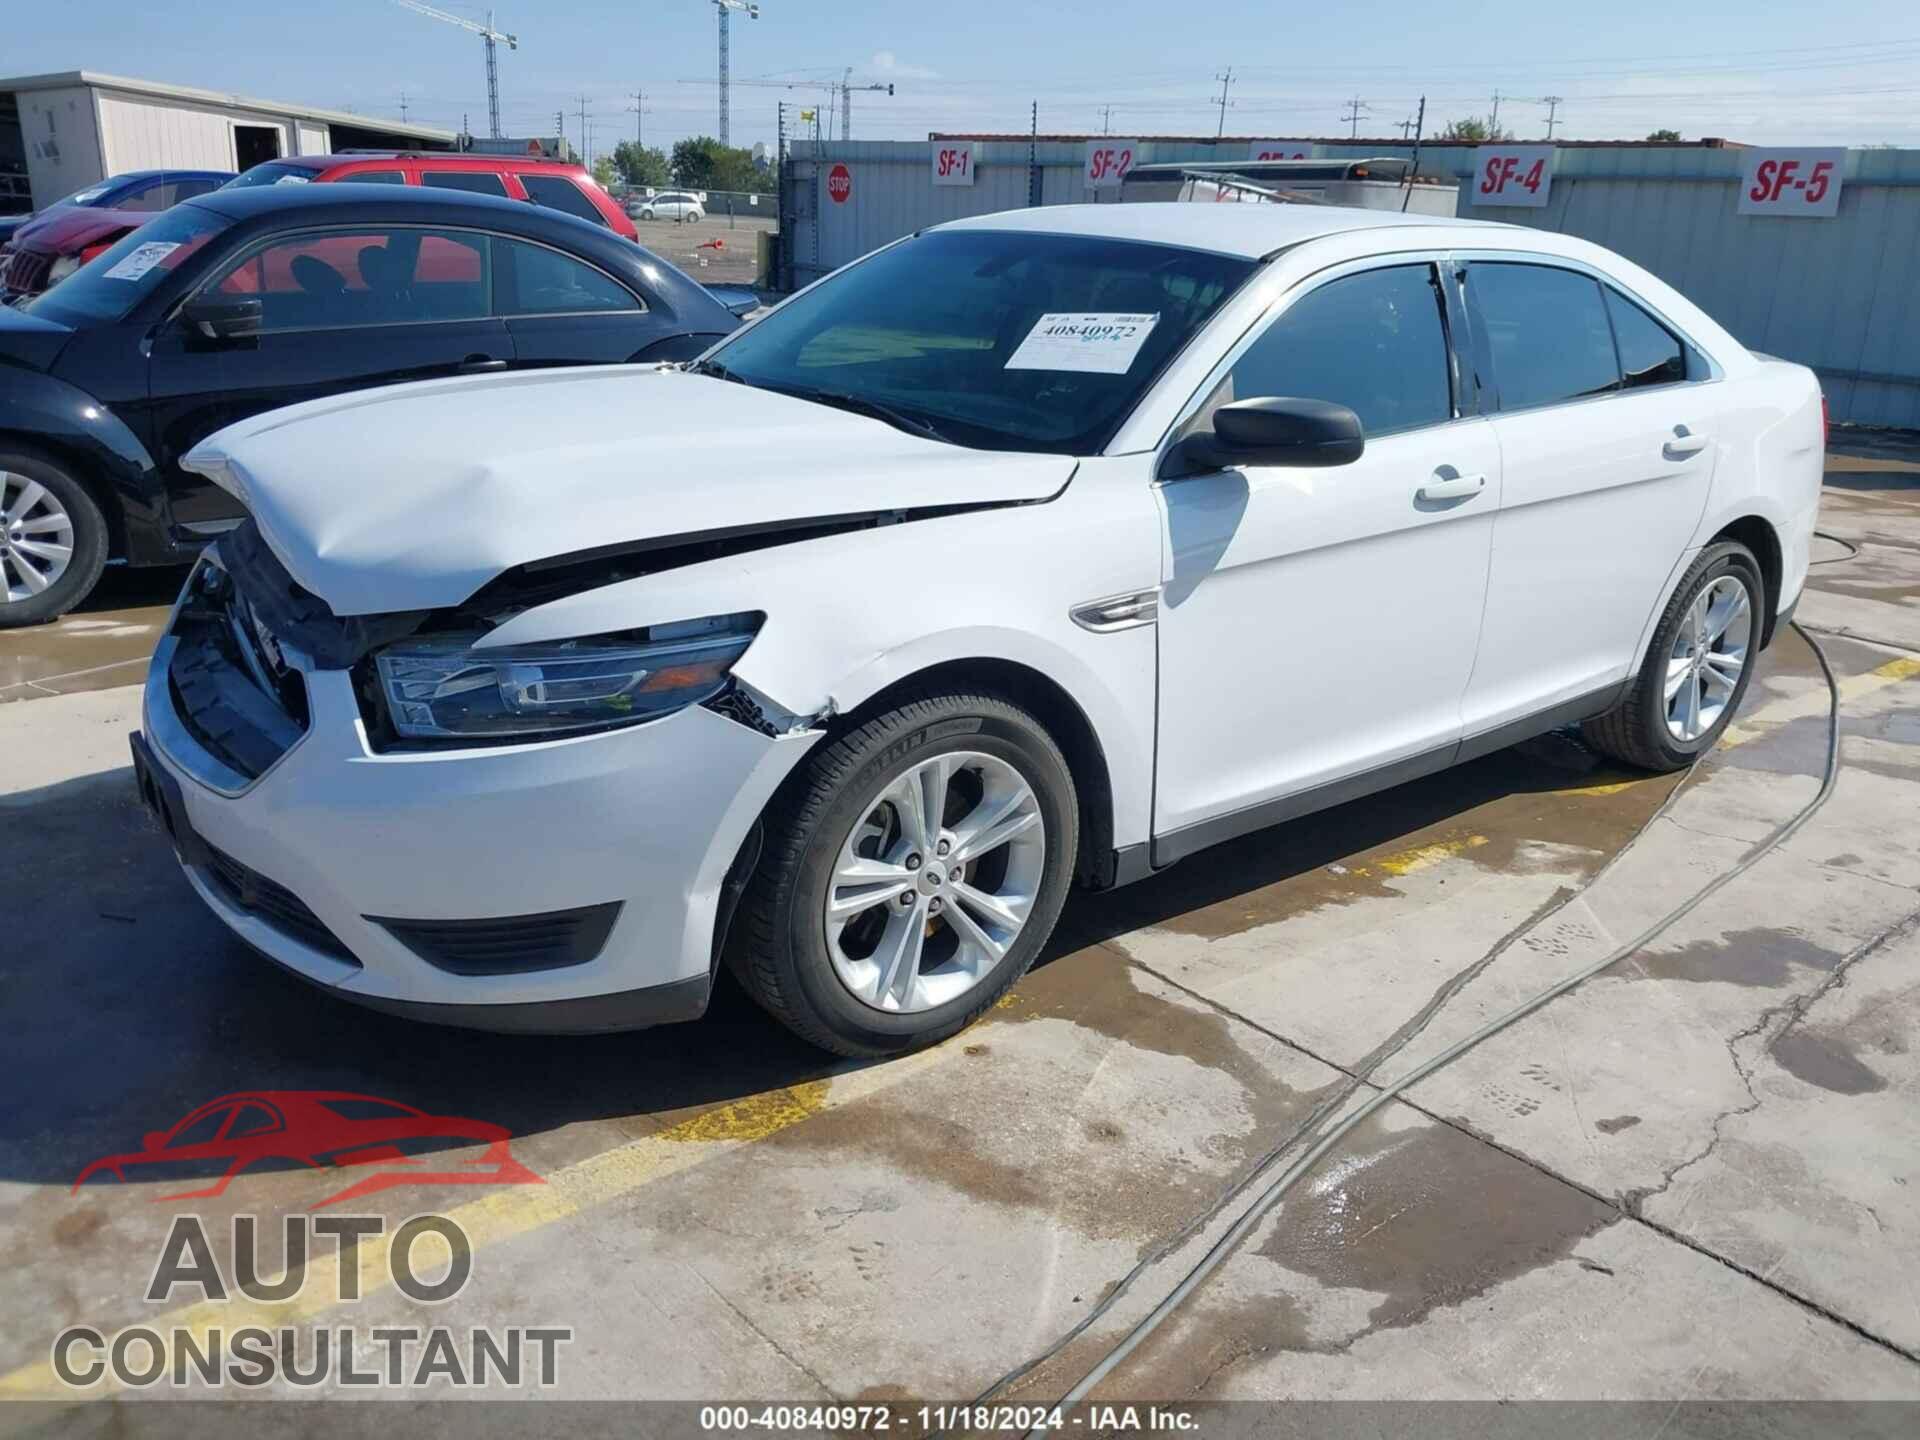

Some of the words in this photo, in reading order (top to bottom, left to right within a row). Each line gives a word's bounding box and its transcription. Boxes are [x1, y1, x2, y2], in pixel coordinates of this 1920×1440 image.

[938, 150, 968, 176] SF-1
[1090, 150, 1131, 178] SF-2
[1481, 157, 1546, 194] SF-4
[830, 176, 849, 192] STOP
[1750, 160, 1833, 202] SF-5
[1043, 325, 1137, 337] 40840972
